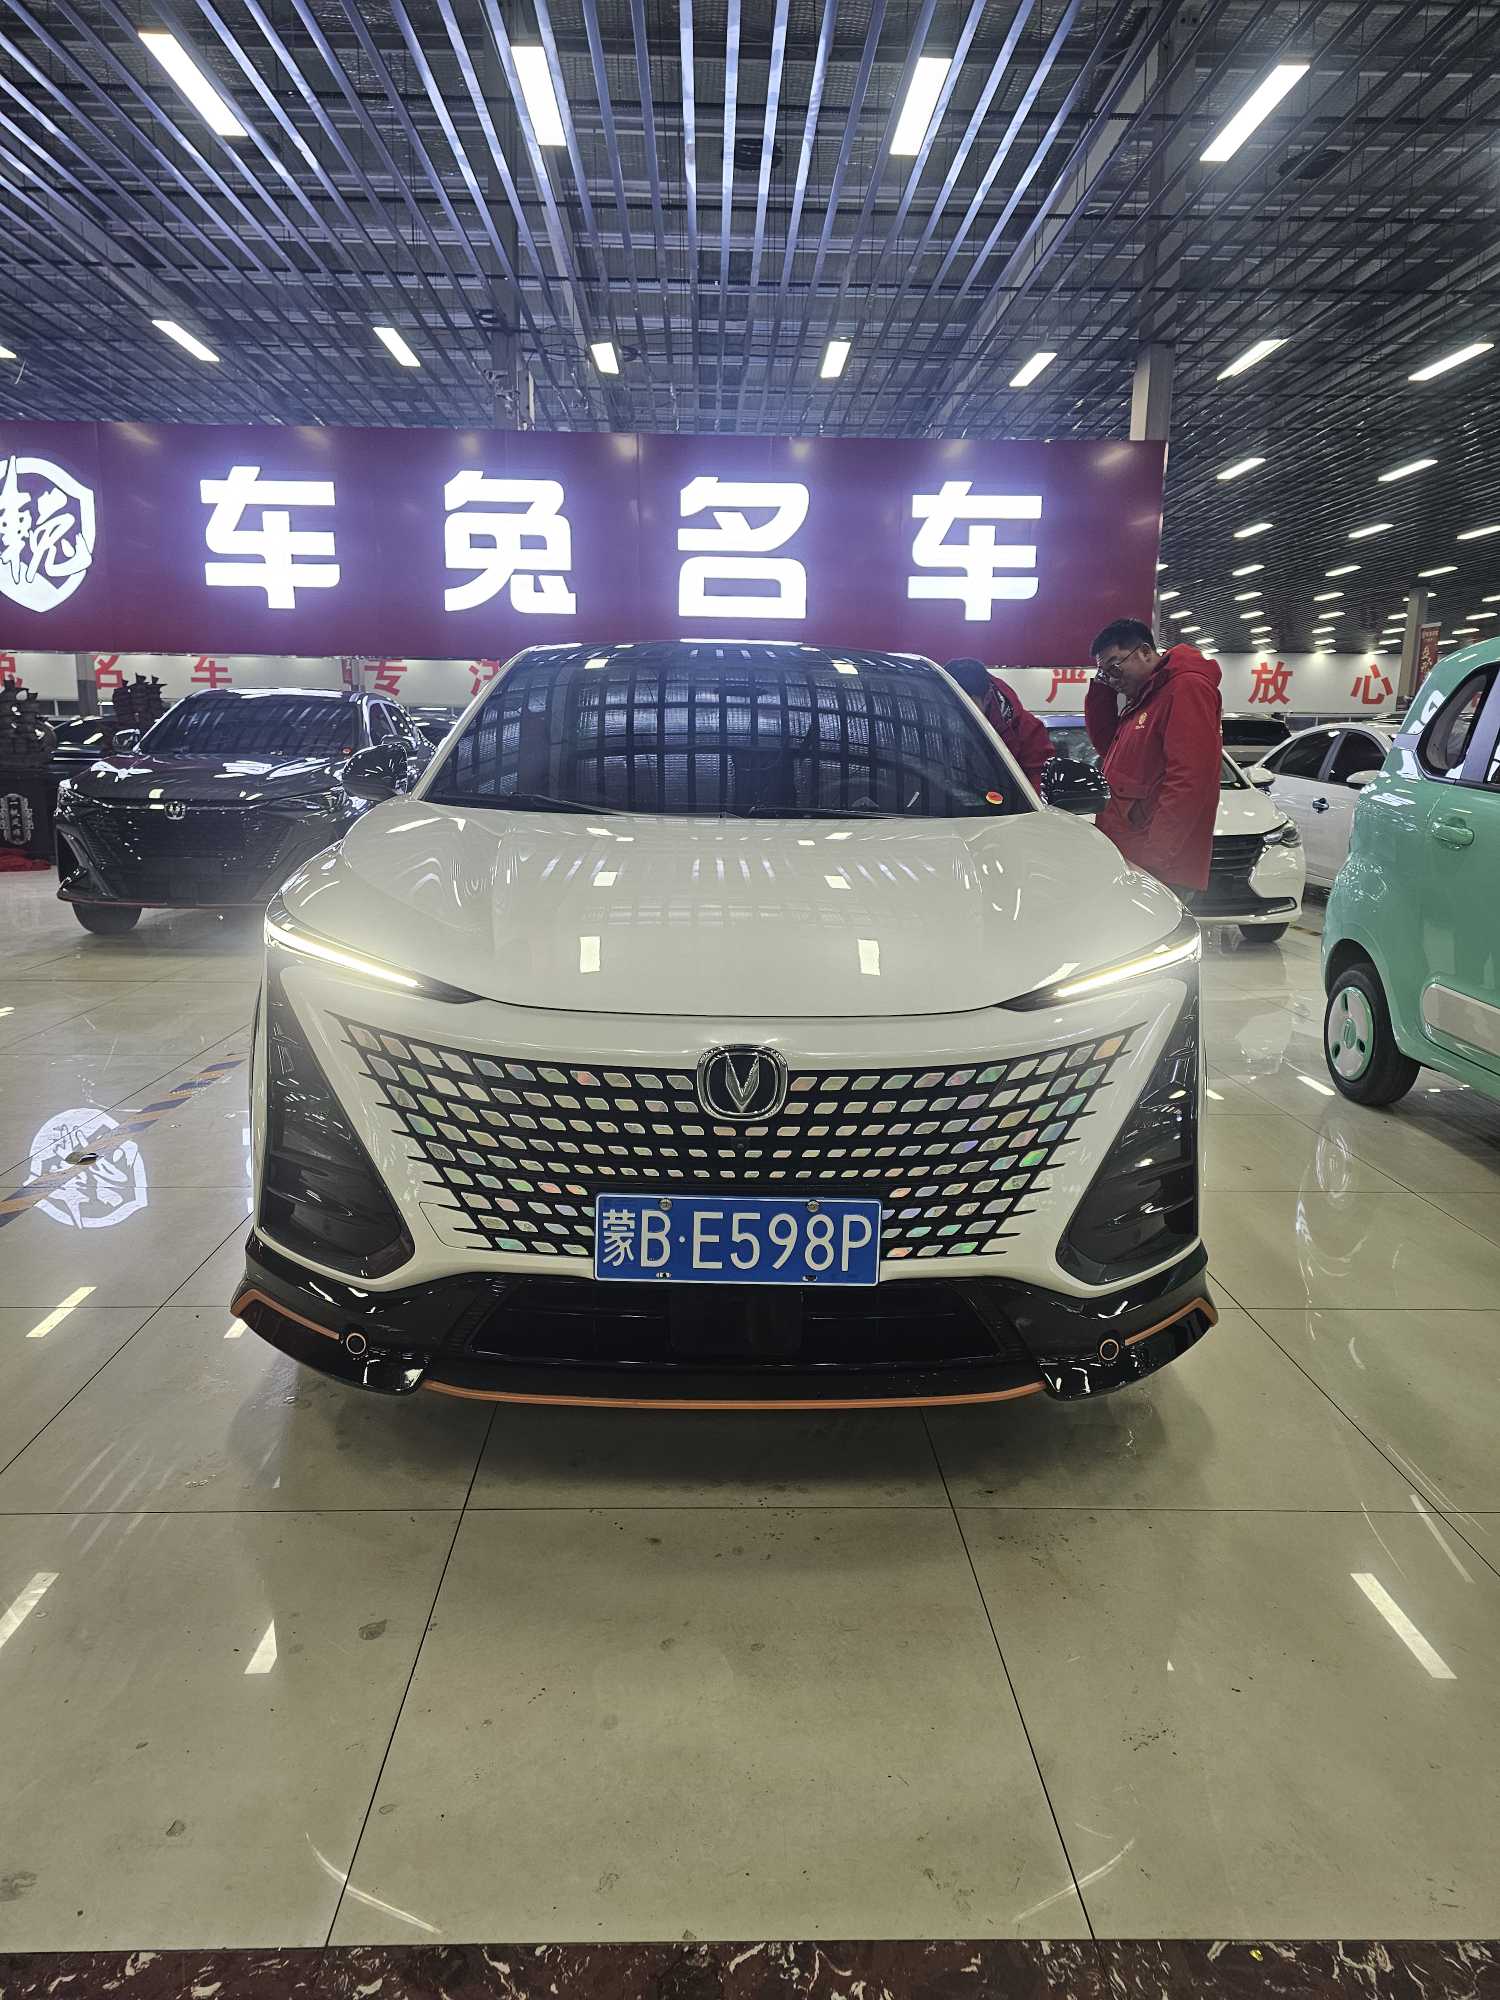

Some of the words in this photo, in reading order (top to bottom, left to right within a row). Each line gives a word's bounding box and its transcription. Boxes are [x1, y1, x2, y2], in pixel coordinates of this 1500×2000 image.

[200, 465, 1043, 621] 车兔名车
[1248, 661, 1393, 705] 放心
[602, 1209, 872, 1272] 蒙B·E598P
